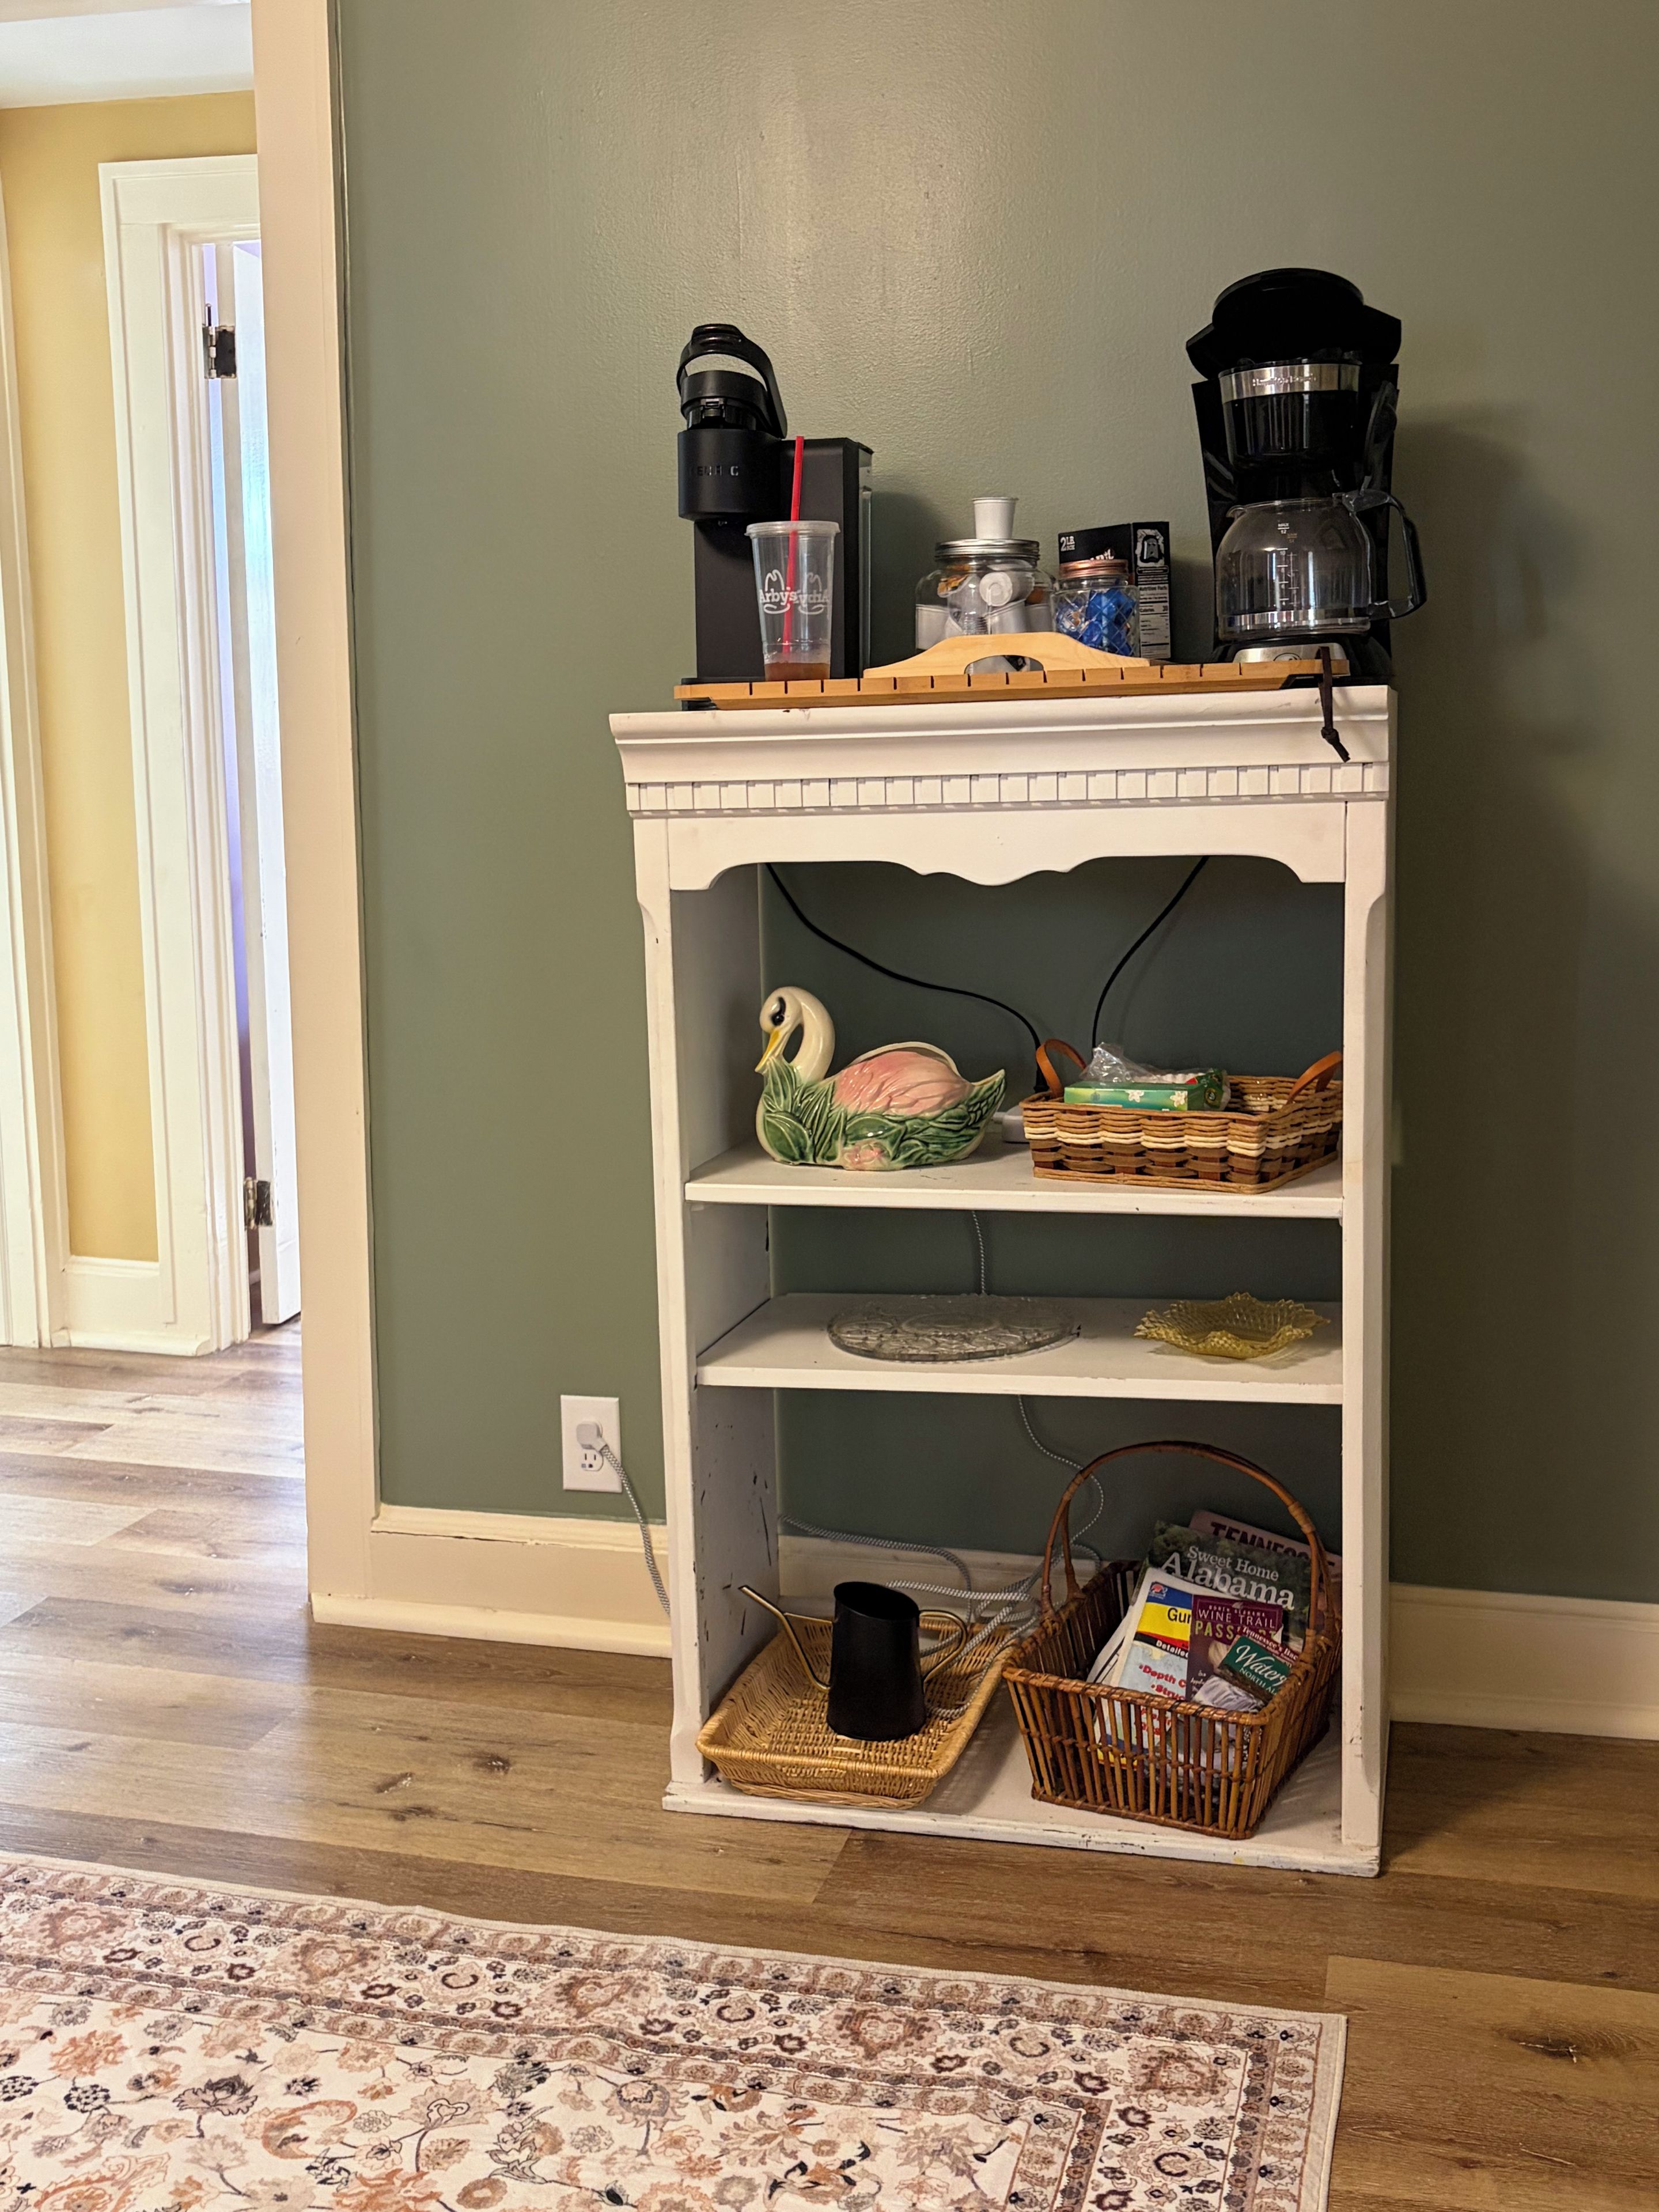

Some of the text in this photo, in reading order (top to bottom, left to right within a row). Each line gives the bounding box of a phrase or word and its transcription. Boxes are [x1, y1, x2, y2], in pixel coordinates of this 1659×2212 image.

[1060, 536, 1067, 552] 2
[759, 586, 798, 605] Arby's
[1187, 1546, 1279, 1581] Sweet Home
[1160, 1552, 1296, 1611] Alabama
[1198, 1609, 1275, 1628] WINE TRAIL
[1143, 1665, 1176, 1684] Depth
[1240, 1668, 1267, 1688] NORTH
